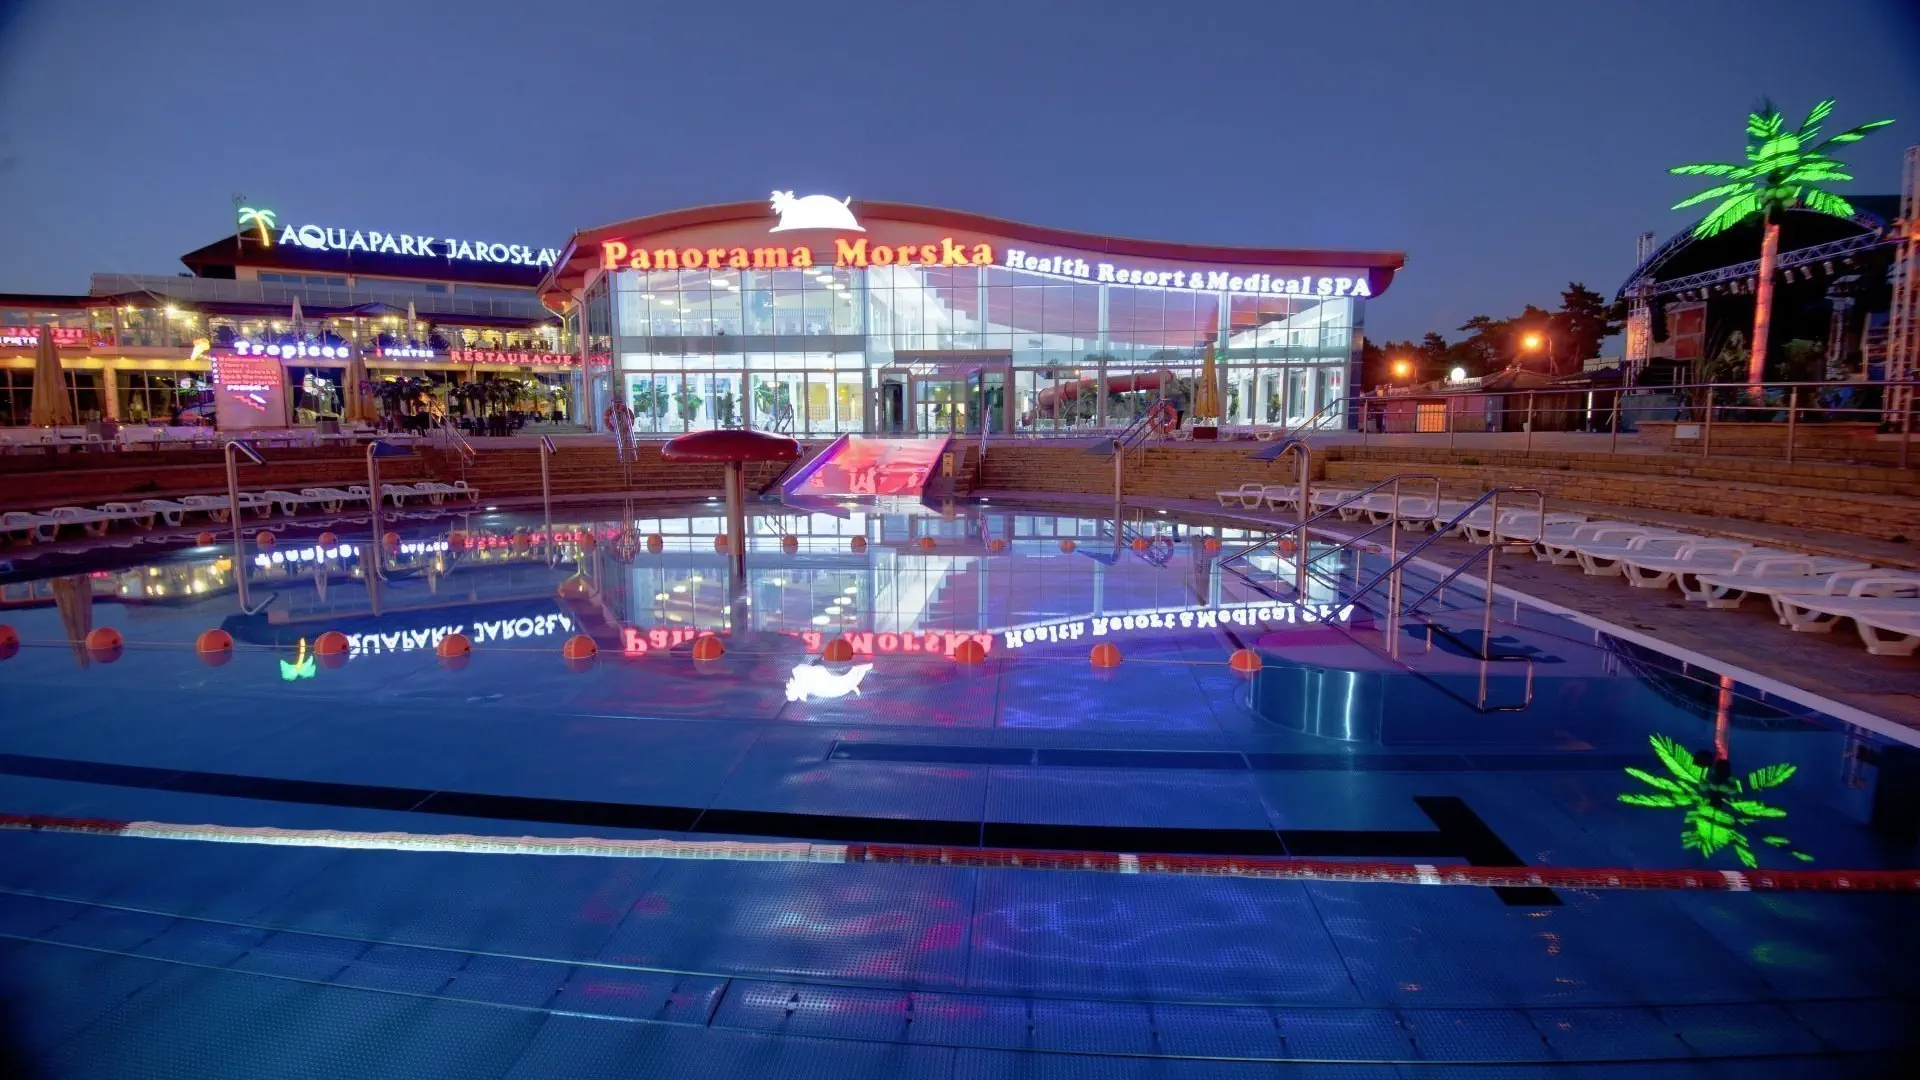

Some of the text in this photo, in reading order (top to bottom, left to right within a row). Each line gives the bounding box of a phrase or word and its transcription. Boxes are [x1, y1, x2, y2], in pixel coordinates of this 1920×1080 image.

[279, 224, 436, 257] AQUAPARK
[602, 237, 993, 270] Panorama Morska
[1005, 249, 1090, 278] Health
[1098, 264, 1185, 288] Resort
[1207, 271, 1311, 294] Medical
[1317, 277, 1371, 297] SPA
[8, 327, 83, 338] JACZZI
[451, 351, 572, 364] RESTAURACJE
